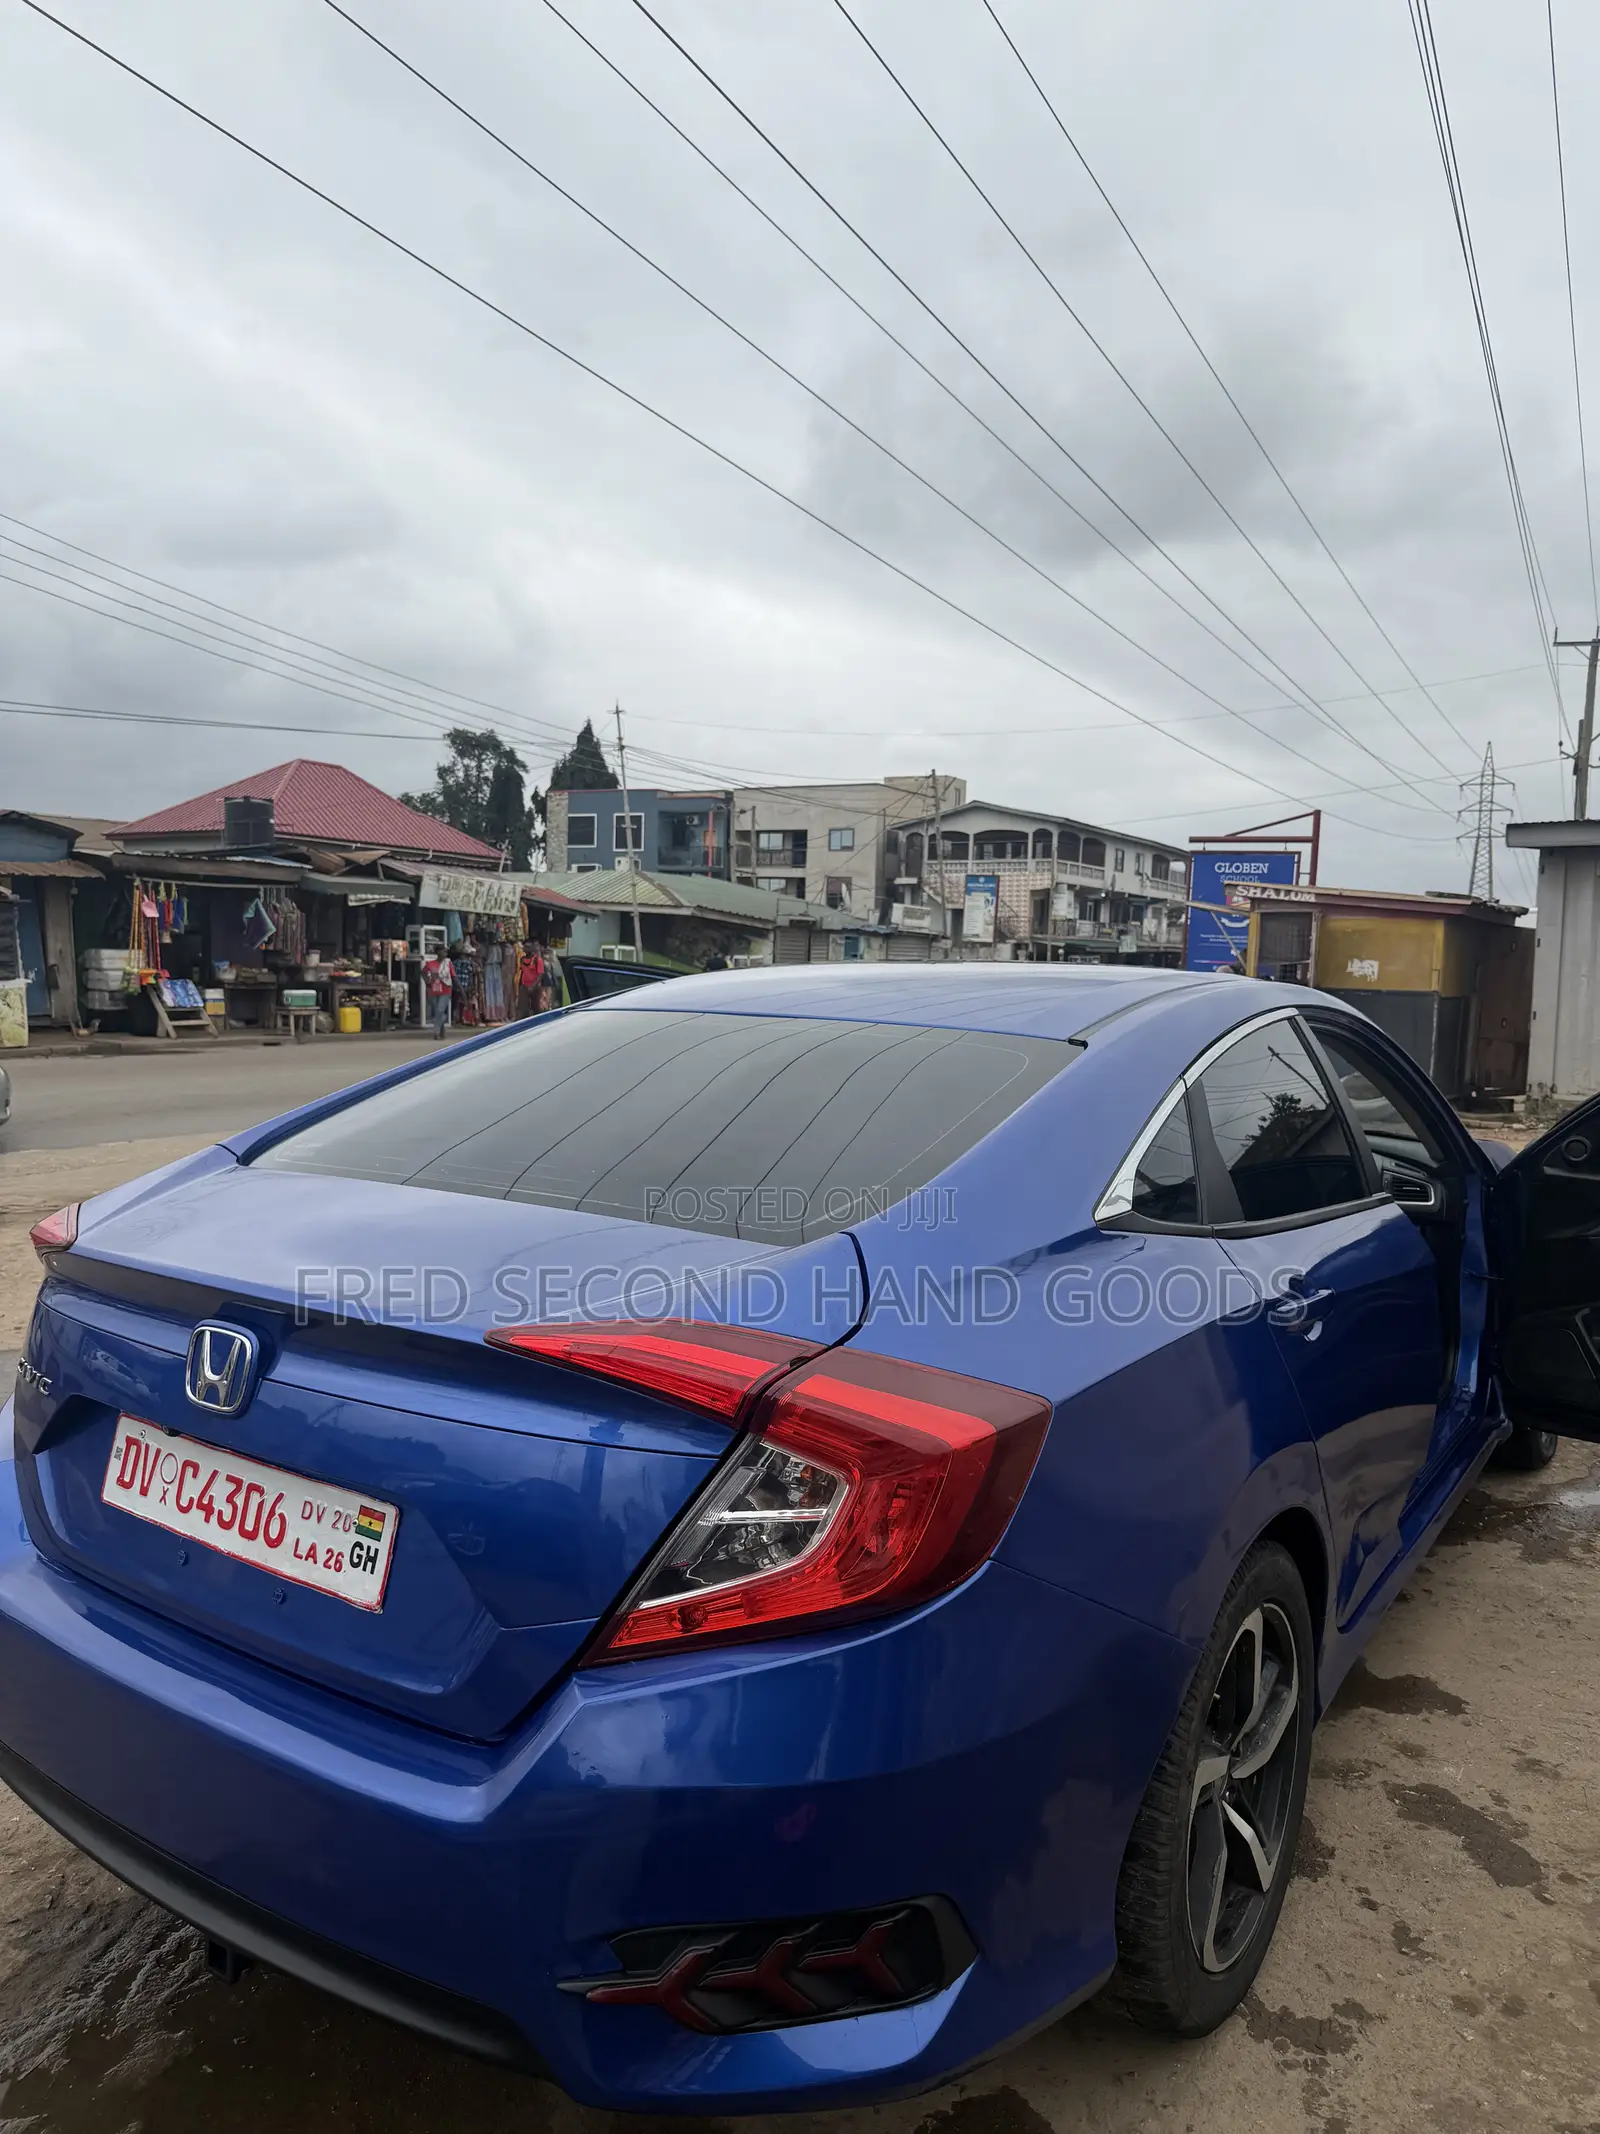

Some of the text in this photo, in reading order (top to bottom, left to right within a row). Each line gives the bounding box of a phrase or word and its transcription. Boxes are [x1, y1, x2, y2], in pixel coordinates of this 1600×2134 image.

[1214, 862, 1270, 874] GLOBEN
[1219, 874, 1261, 883] SCHOOL
[17, 1356, 54, 1396] CIVIC
[116, 1435, 287, 1549] DV C4306
[300, 1499, 353, 1533] DV 20
[293, 1537, 345, 1573] LA 26
[349, 1540, 380, 1575] GH
